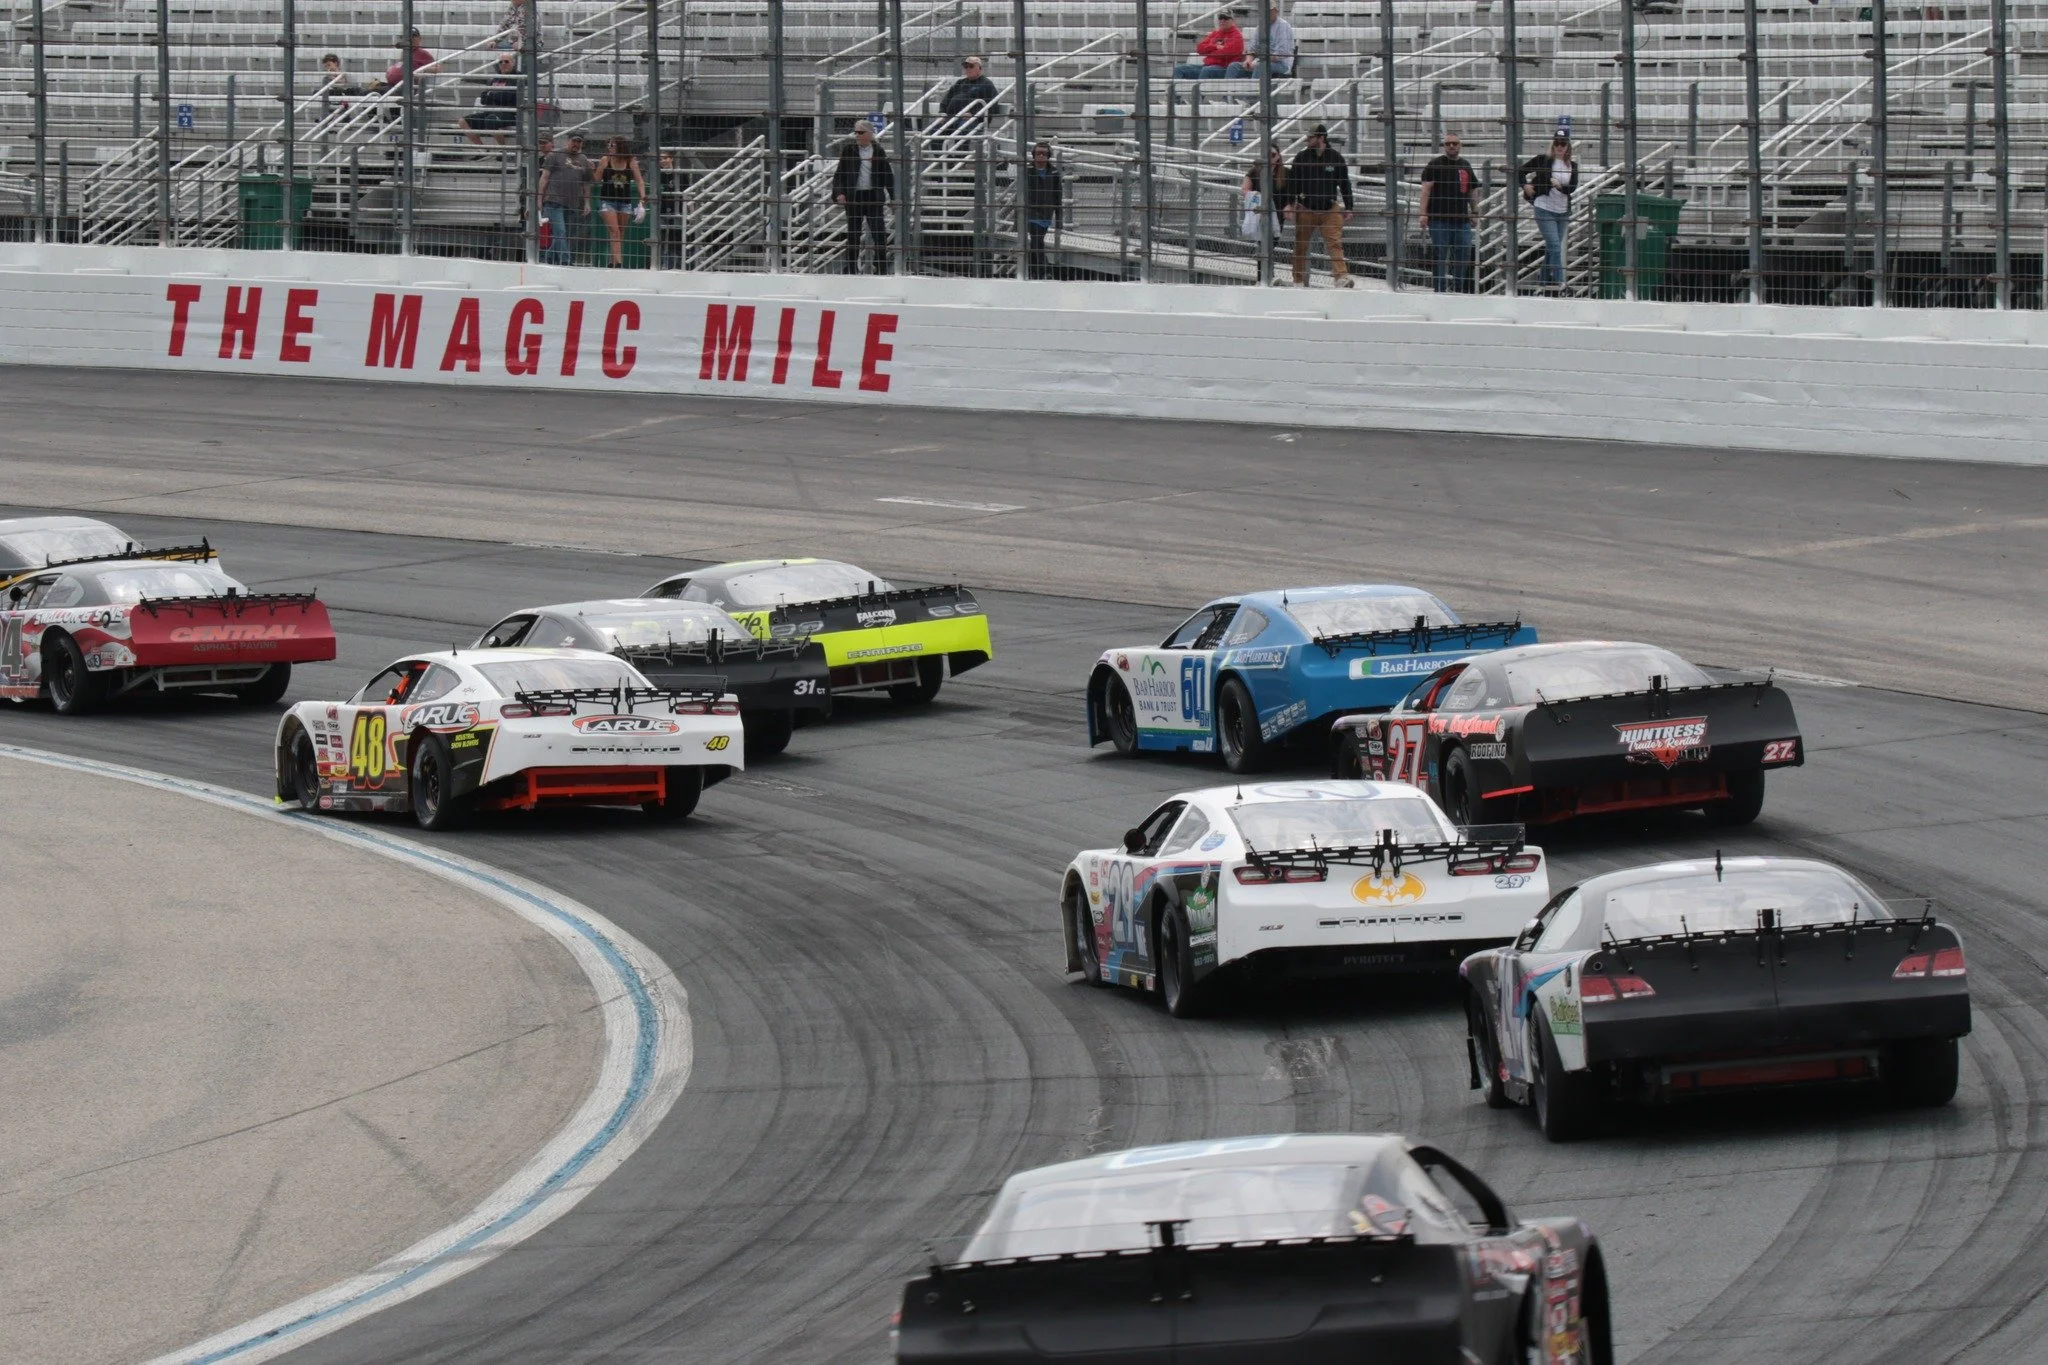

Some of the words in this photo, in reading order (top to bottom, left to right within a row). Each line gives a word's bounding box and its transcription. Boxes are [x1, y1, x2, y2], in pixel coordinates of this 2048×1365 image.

[168, 285, 316, 360] THE
[367, 295, 639, 377] MAGIC
[701, 305, 896, 390] MILE
[170, 624, 300, 642] CENTRAL
[193, 642, 237, 652] ASPHALT
[239, 641, 277, 650] PAVING
[847, 643, 923, 660] CAMARO
[793, 679, 816, 695] 31
[1139, 700, 1155, 711] BANK
[1160, 701, 1177, 712] TRUST
[403, 702, 480, 735] LARUE
[581, 719, 677, 735] LARUE
[1448, 713, 1502, 739] England
[1619, 722, 1706, 743] HUNTRESS
[350, 715, 386, 778] 48
[570, 744, 684, 754] CAMARO
[706, 735, 730, 751] 48
[1470, 743, 1507, 760] ROOFING
[1627, 738, 1663, 752] Trailer
[1666, 736, 1701, 749] Rental
[1762, 740, 1793, 762] 27
[1388, 719, 1427, 788] 27
[1494, 874, 1524, 889] 29
[1316, 911, 1466, 929] CAMARO
